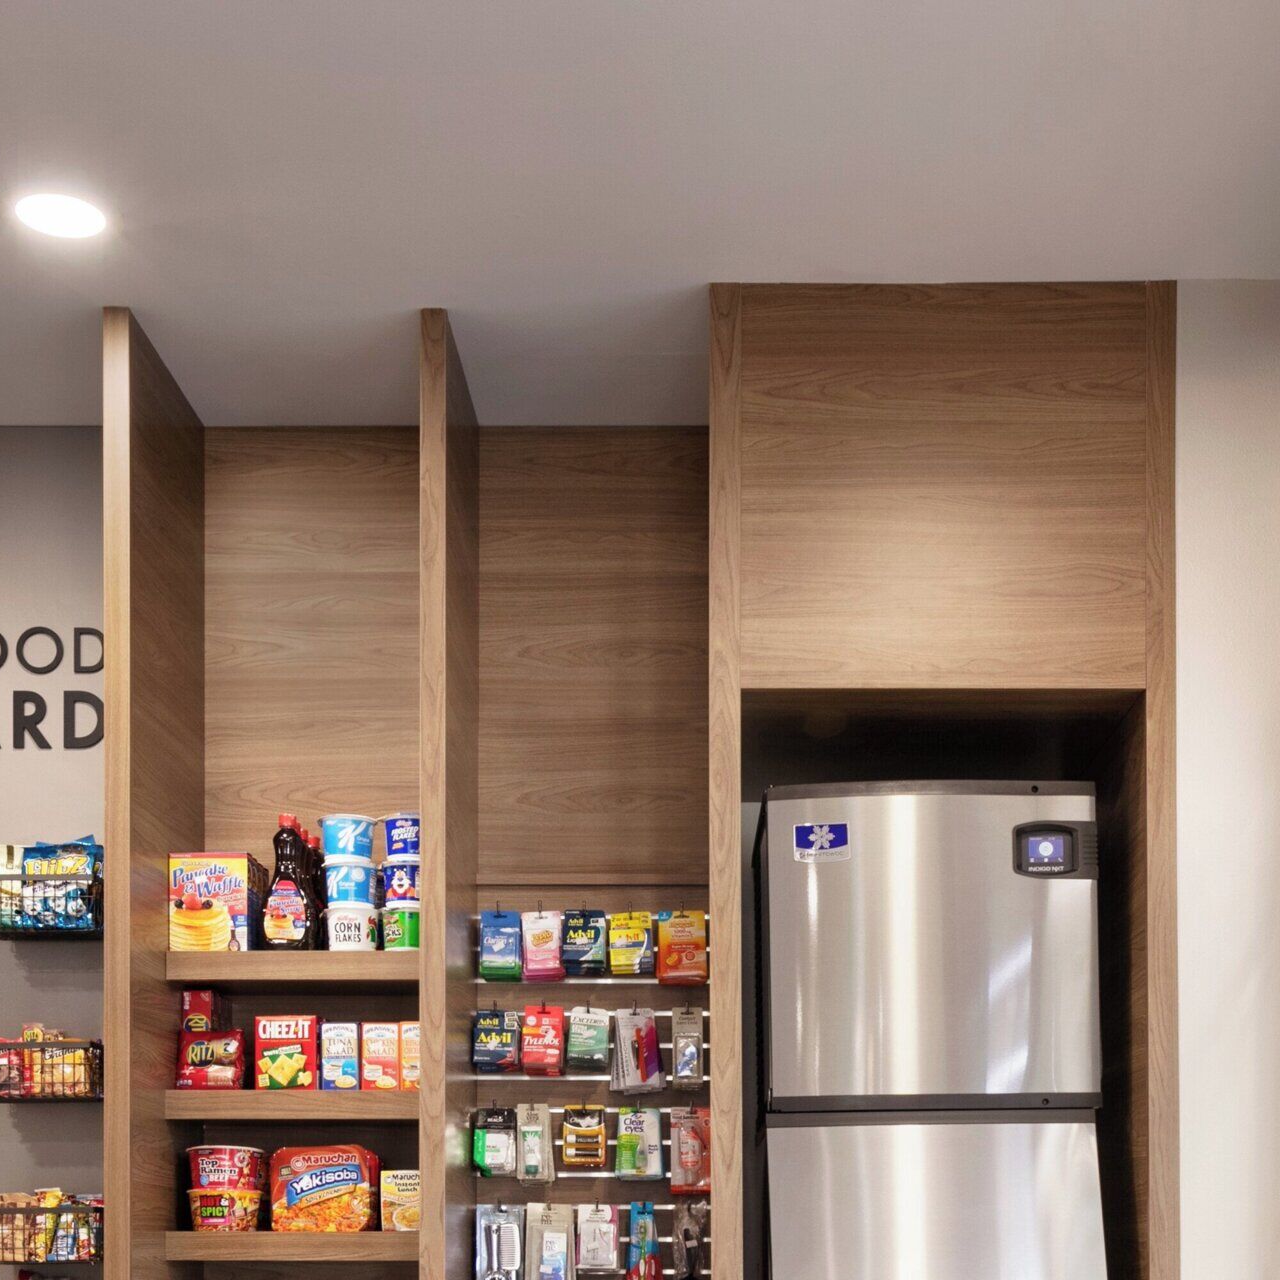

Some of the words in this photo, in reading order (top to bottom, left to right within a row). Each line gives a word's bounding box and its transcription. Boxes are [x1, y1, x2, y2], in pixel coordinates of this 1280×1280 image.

[172, 865, 228, 887] Pancake
[196, 878, 245, 898] Waffle
[334, 922, 361, 933] CORN
[335, 933, 362, 943] FLAKES
[258, 1020, 311, 1039] CHEEZ-IT
[327, 1039, 352, 1047] TUNA
[187, 1043, 215, 1063] RITZ
[623, 1118, 644, 1126] Clear
[624, 1125, 645, 1133] eyes
[199, 1159, 219, 1168] Top
[303, 1154, 358, 1165] Maruchan
[200, 1166, 237, 1176] Ramen
[289, 1169, 360, 1196] Yakisoba
[201, 1206, 229, 1217] SPICY
